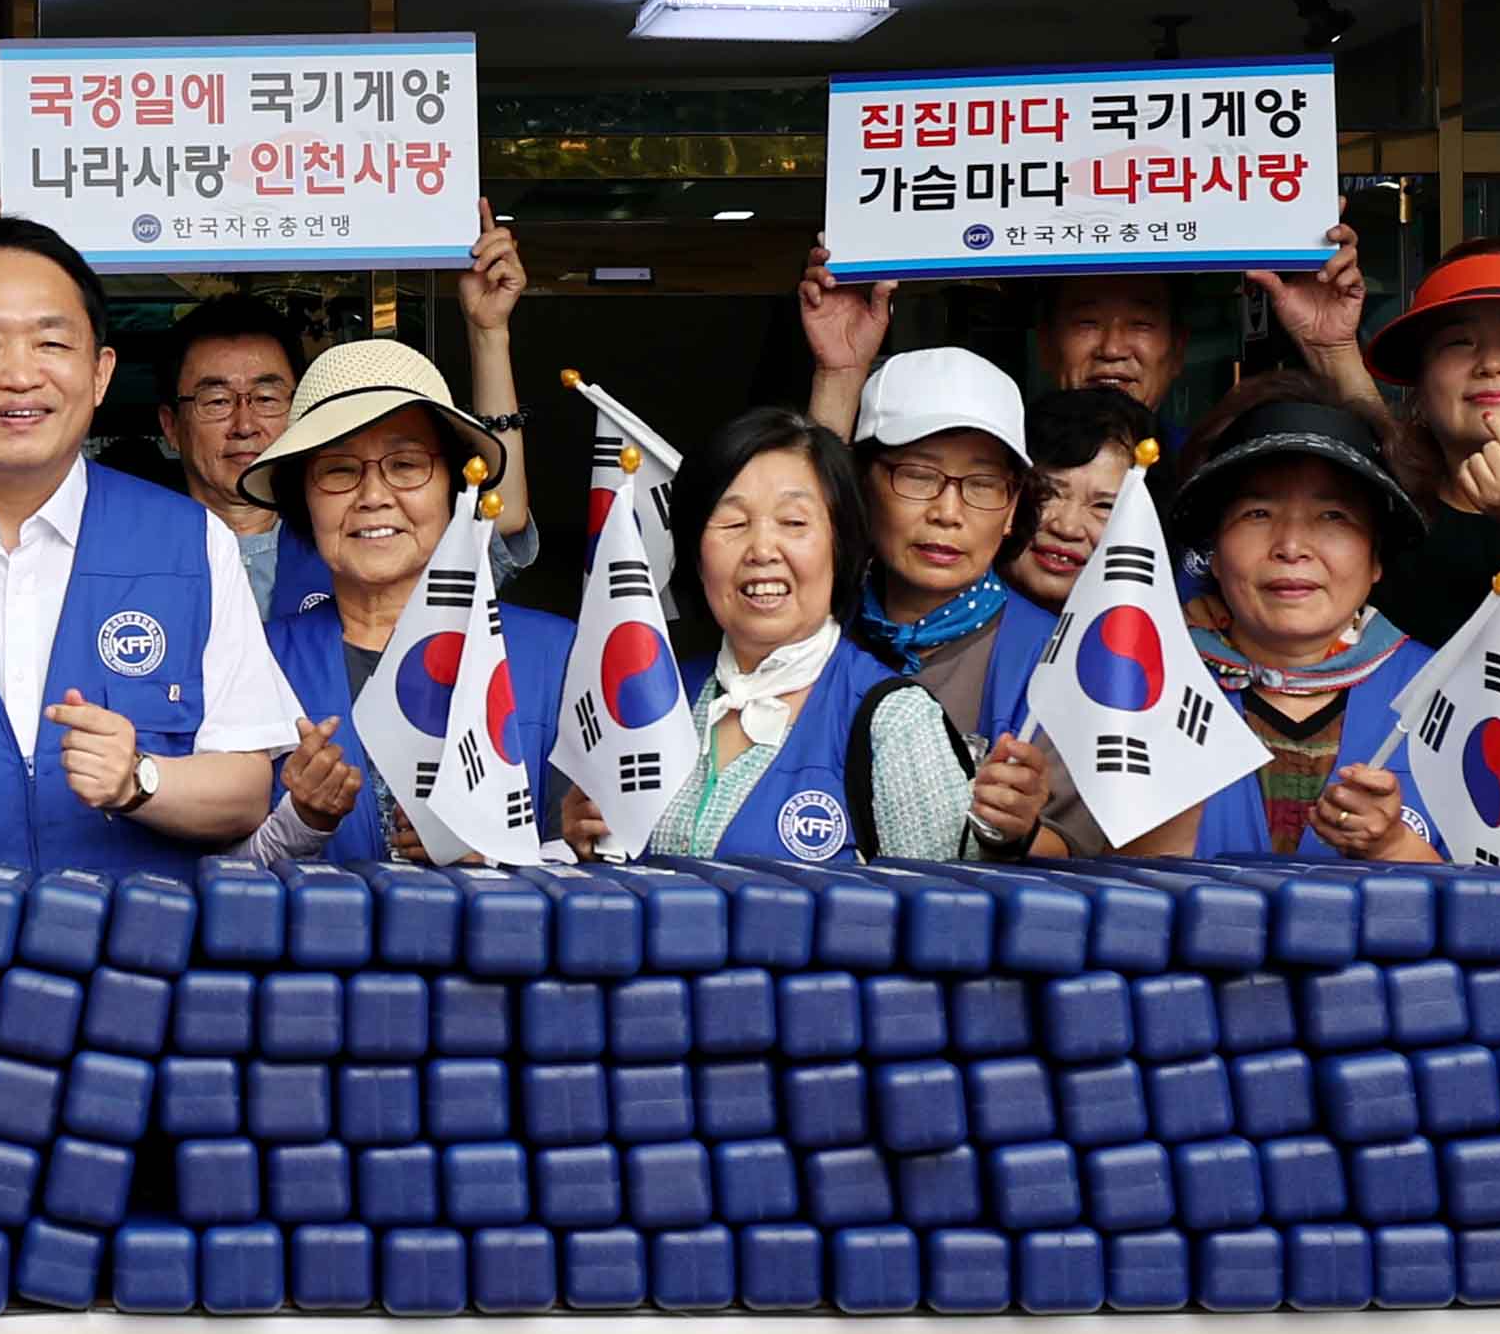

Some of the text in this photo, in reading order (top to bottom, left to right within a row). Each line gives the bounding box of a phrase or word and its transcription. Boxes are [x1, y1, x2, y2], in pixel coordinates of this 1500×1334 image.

[30, 70, 449, 128] 국경일에 국기게양
[860, 89, 1307, 149] 집집마다 국기게양
[33, 142, 451, 198] 나라사랑 인천사랑
[860, 154, 1308, 212] 가슴마다 나라사랑
[136, 222, 157, 235] KFF
[174, 216, 349, 238] 한국자유총연맹
[968, 232, 989, 243] KFF
[1005, 222, 1199, 245] 한국자유총연맹
[113, 636, 152, 655] KFF
[794, 815, 835, 839] KFF
